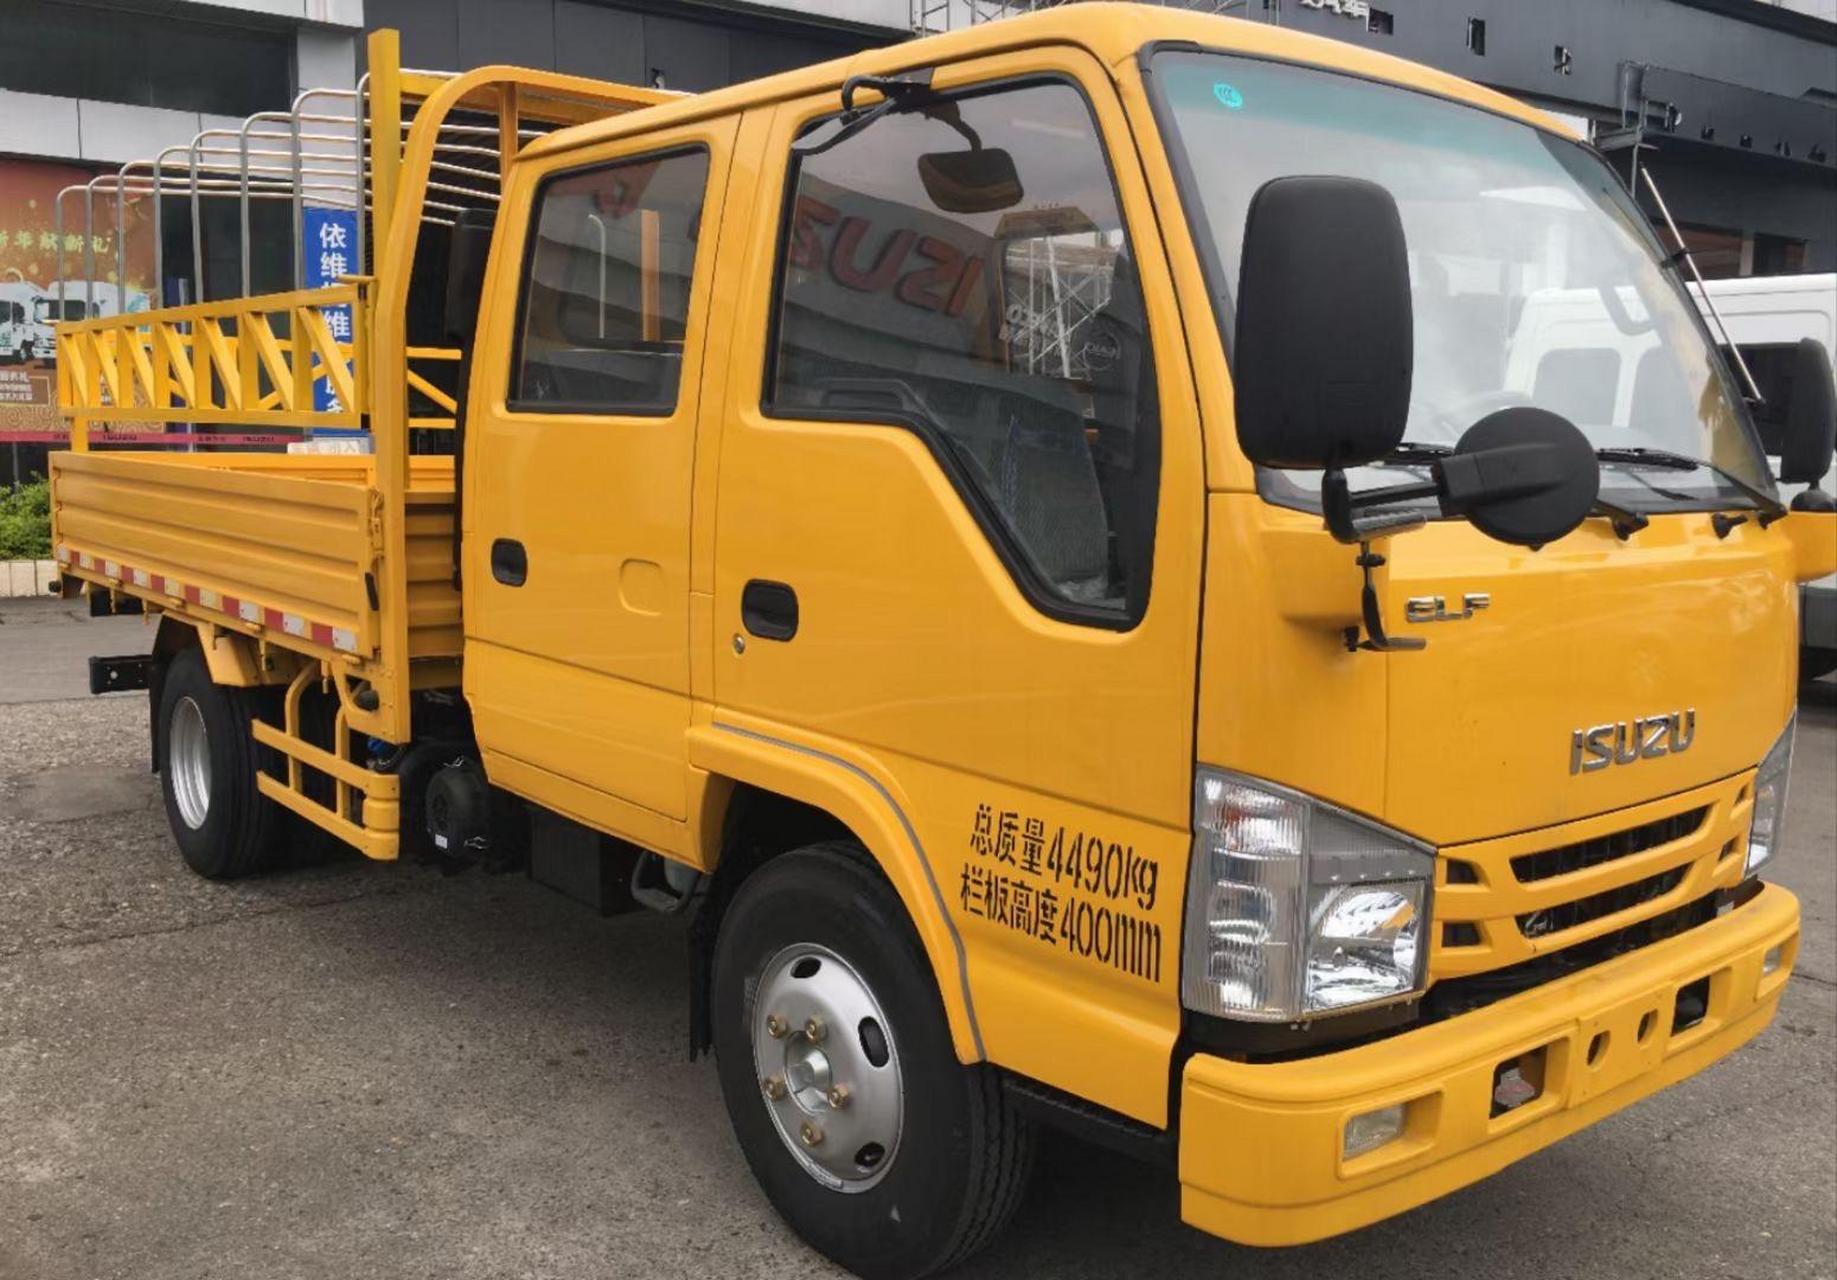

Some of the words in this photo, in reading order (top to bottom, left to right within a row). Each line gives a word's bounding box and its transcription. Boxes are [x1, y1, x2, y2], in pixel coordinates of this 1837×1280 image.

[1405, 592, 1491, 623] ELF
[1569, 707, 1696, 777] ISUZU
[969, 803, 1159, 910] 总质量4490kg
[960, 862, 1161, 983] 栏板高度400mm
